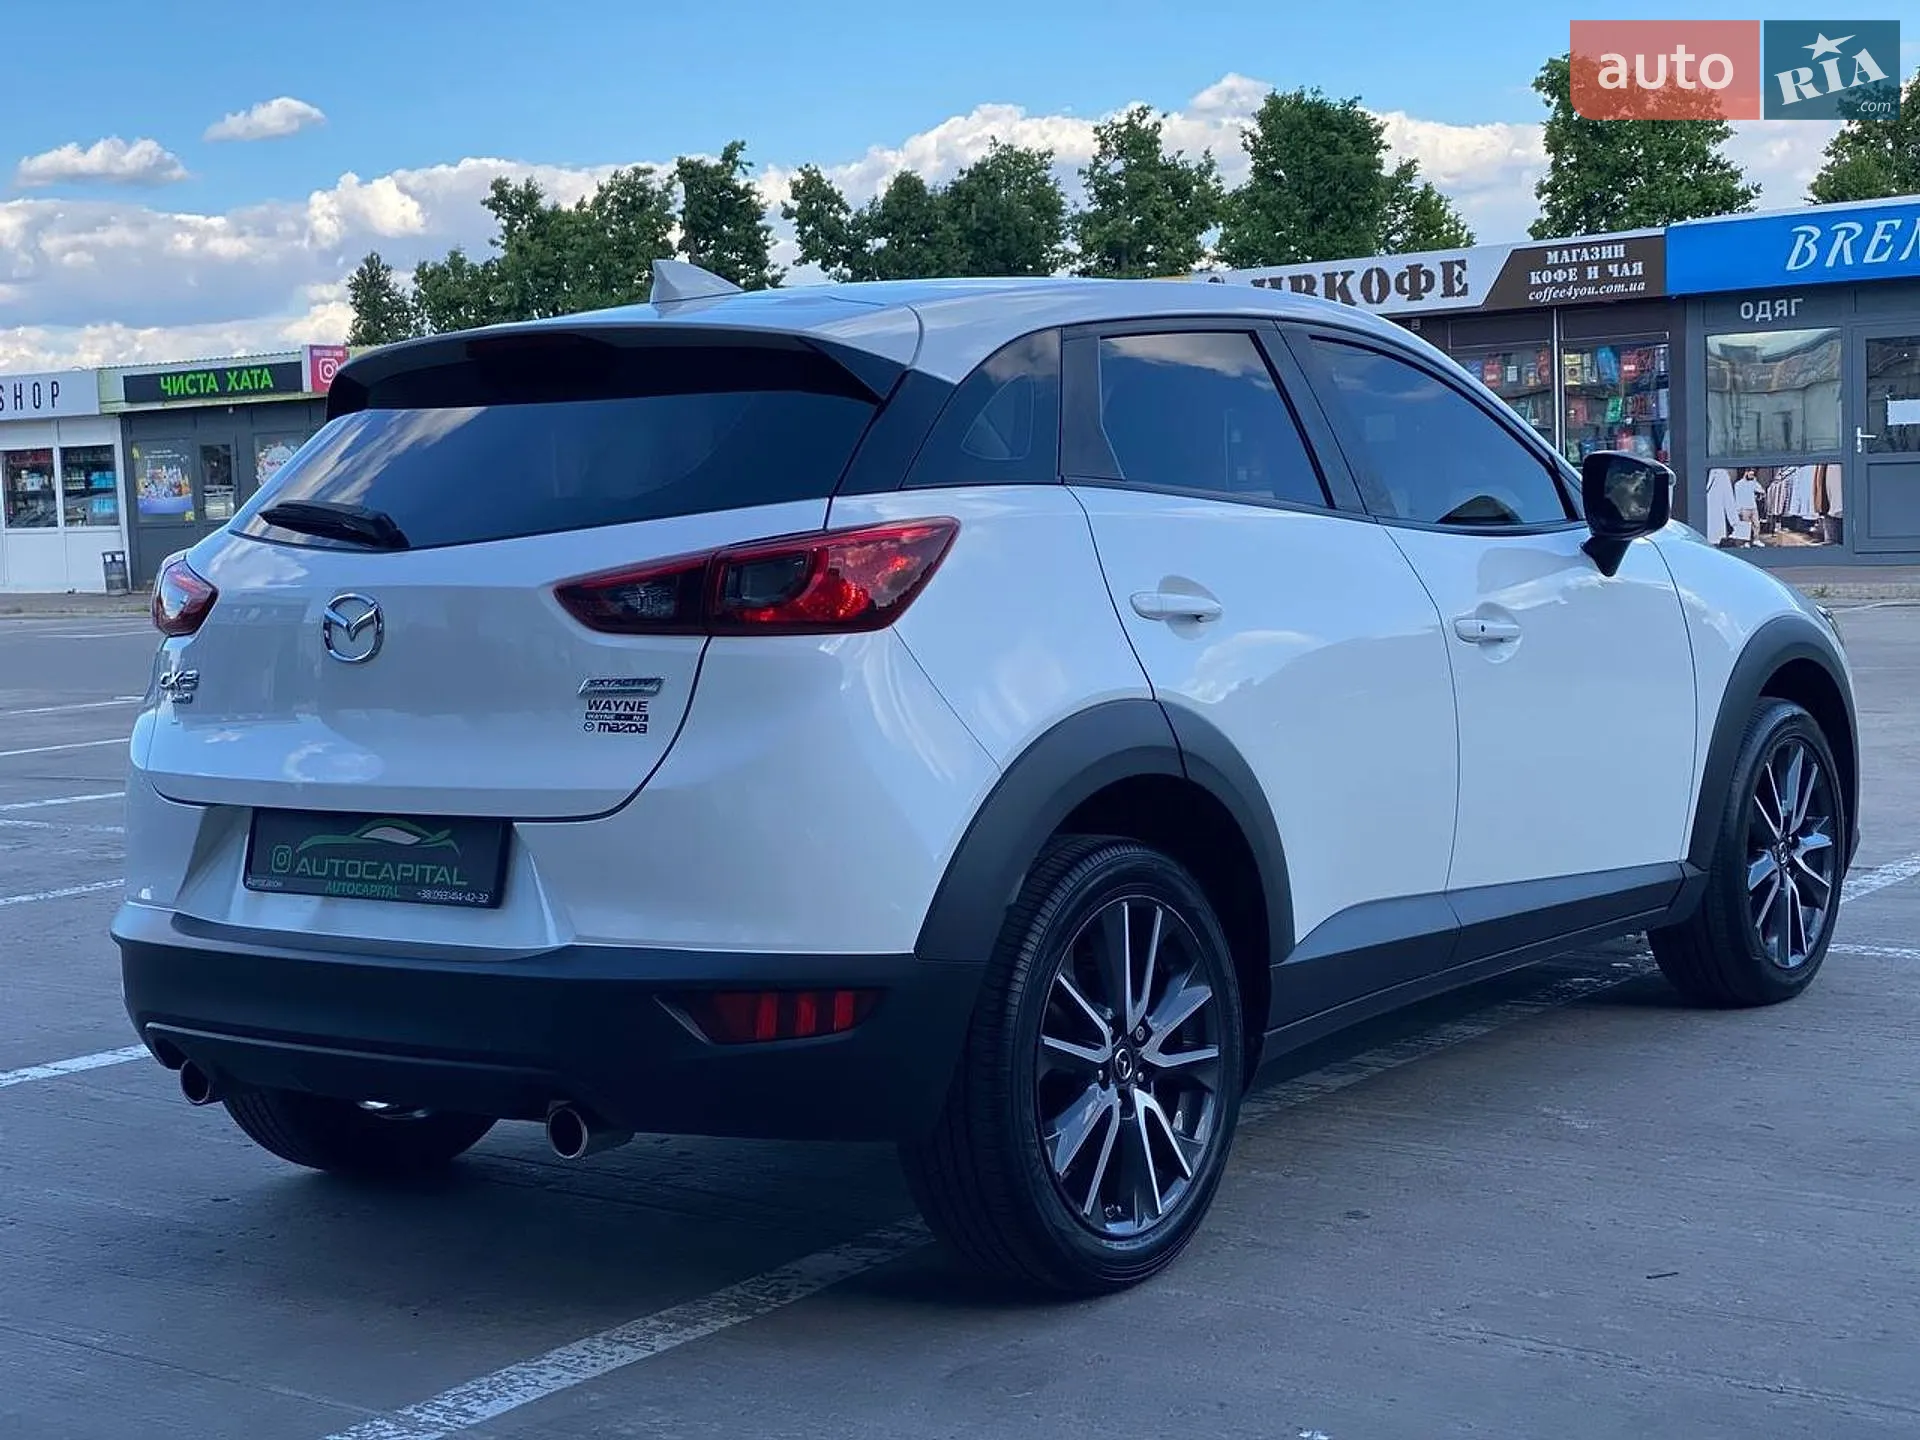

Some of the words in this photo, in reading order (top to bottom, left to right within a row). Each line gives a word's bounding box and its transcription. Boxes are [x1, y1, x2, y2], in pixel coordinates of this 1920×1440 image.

[1546, 244, 1625, 265] МАГАЗИН
[1529, 267, 1578, 285] КОФЕ
[1586, 265, 1599, 280] И
[1607, 261, 1643, 278] ЧАЯ
[1528, 281, 1646, 303] coffee4you.com.ua
[160, 371, 219, 396] ЧИСТА
[226, 367, 274, 392] ХАТА
[587, 699, 649, 713] WAYNE
[295, 857, 468, 886] AUTOCAPITAL
[325, 880, 400, 898] AUTOCAPITAL
